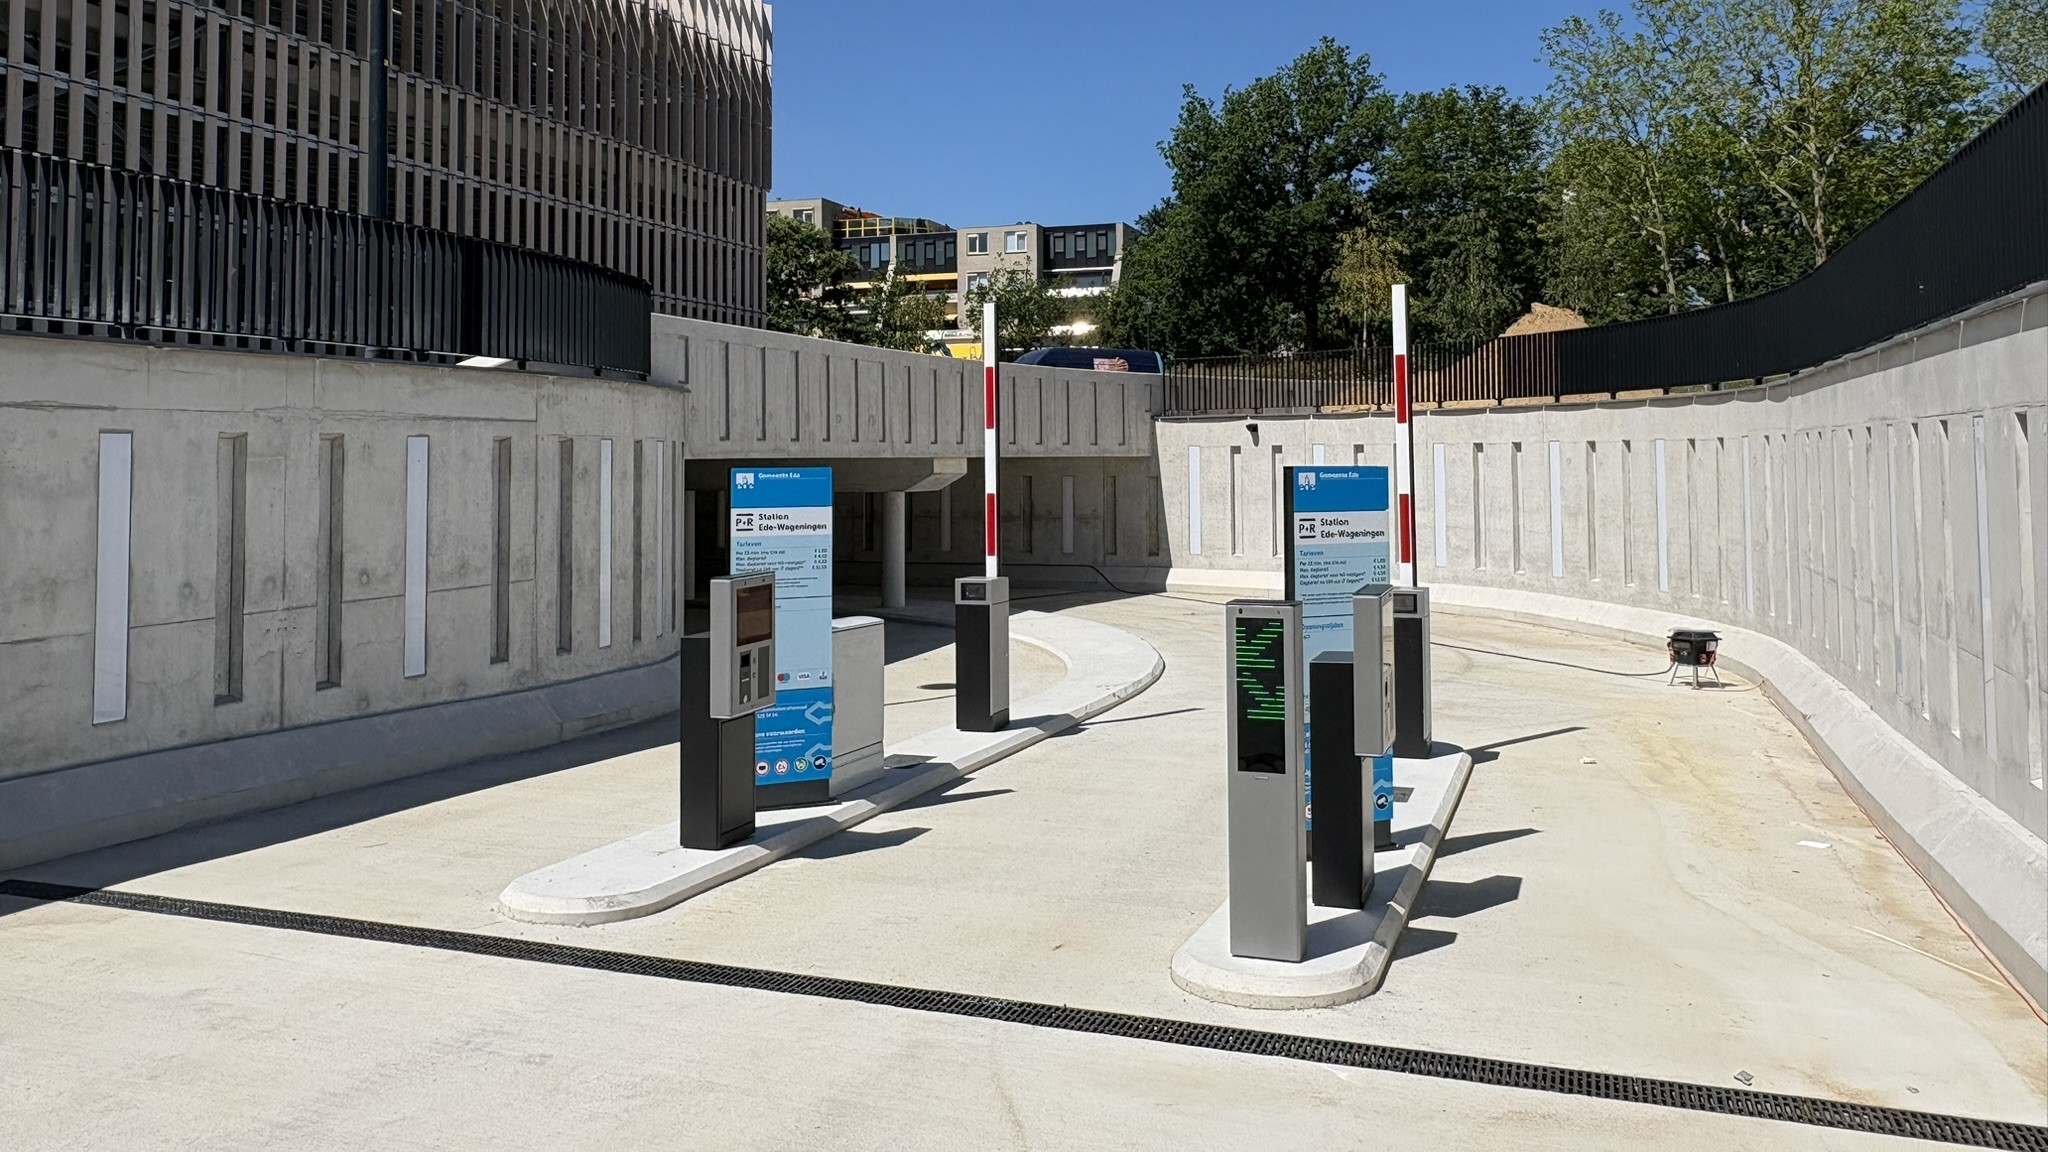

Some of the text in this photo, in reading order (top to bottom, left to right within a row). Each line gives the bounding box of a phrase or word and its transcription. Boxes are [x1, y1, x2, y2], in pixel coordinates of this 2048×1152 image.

[736, 518, 754, 526] P+R
[1320, 518, 1349, 526] Station
[758, 523, 827, 532] Ede-Wageningen
[1299, 524, 1316, 533] P+R
[1320, 529, 1384, 539] Ede-Wageningen
[766, 728, 806, 737] voorwaarden
